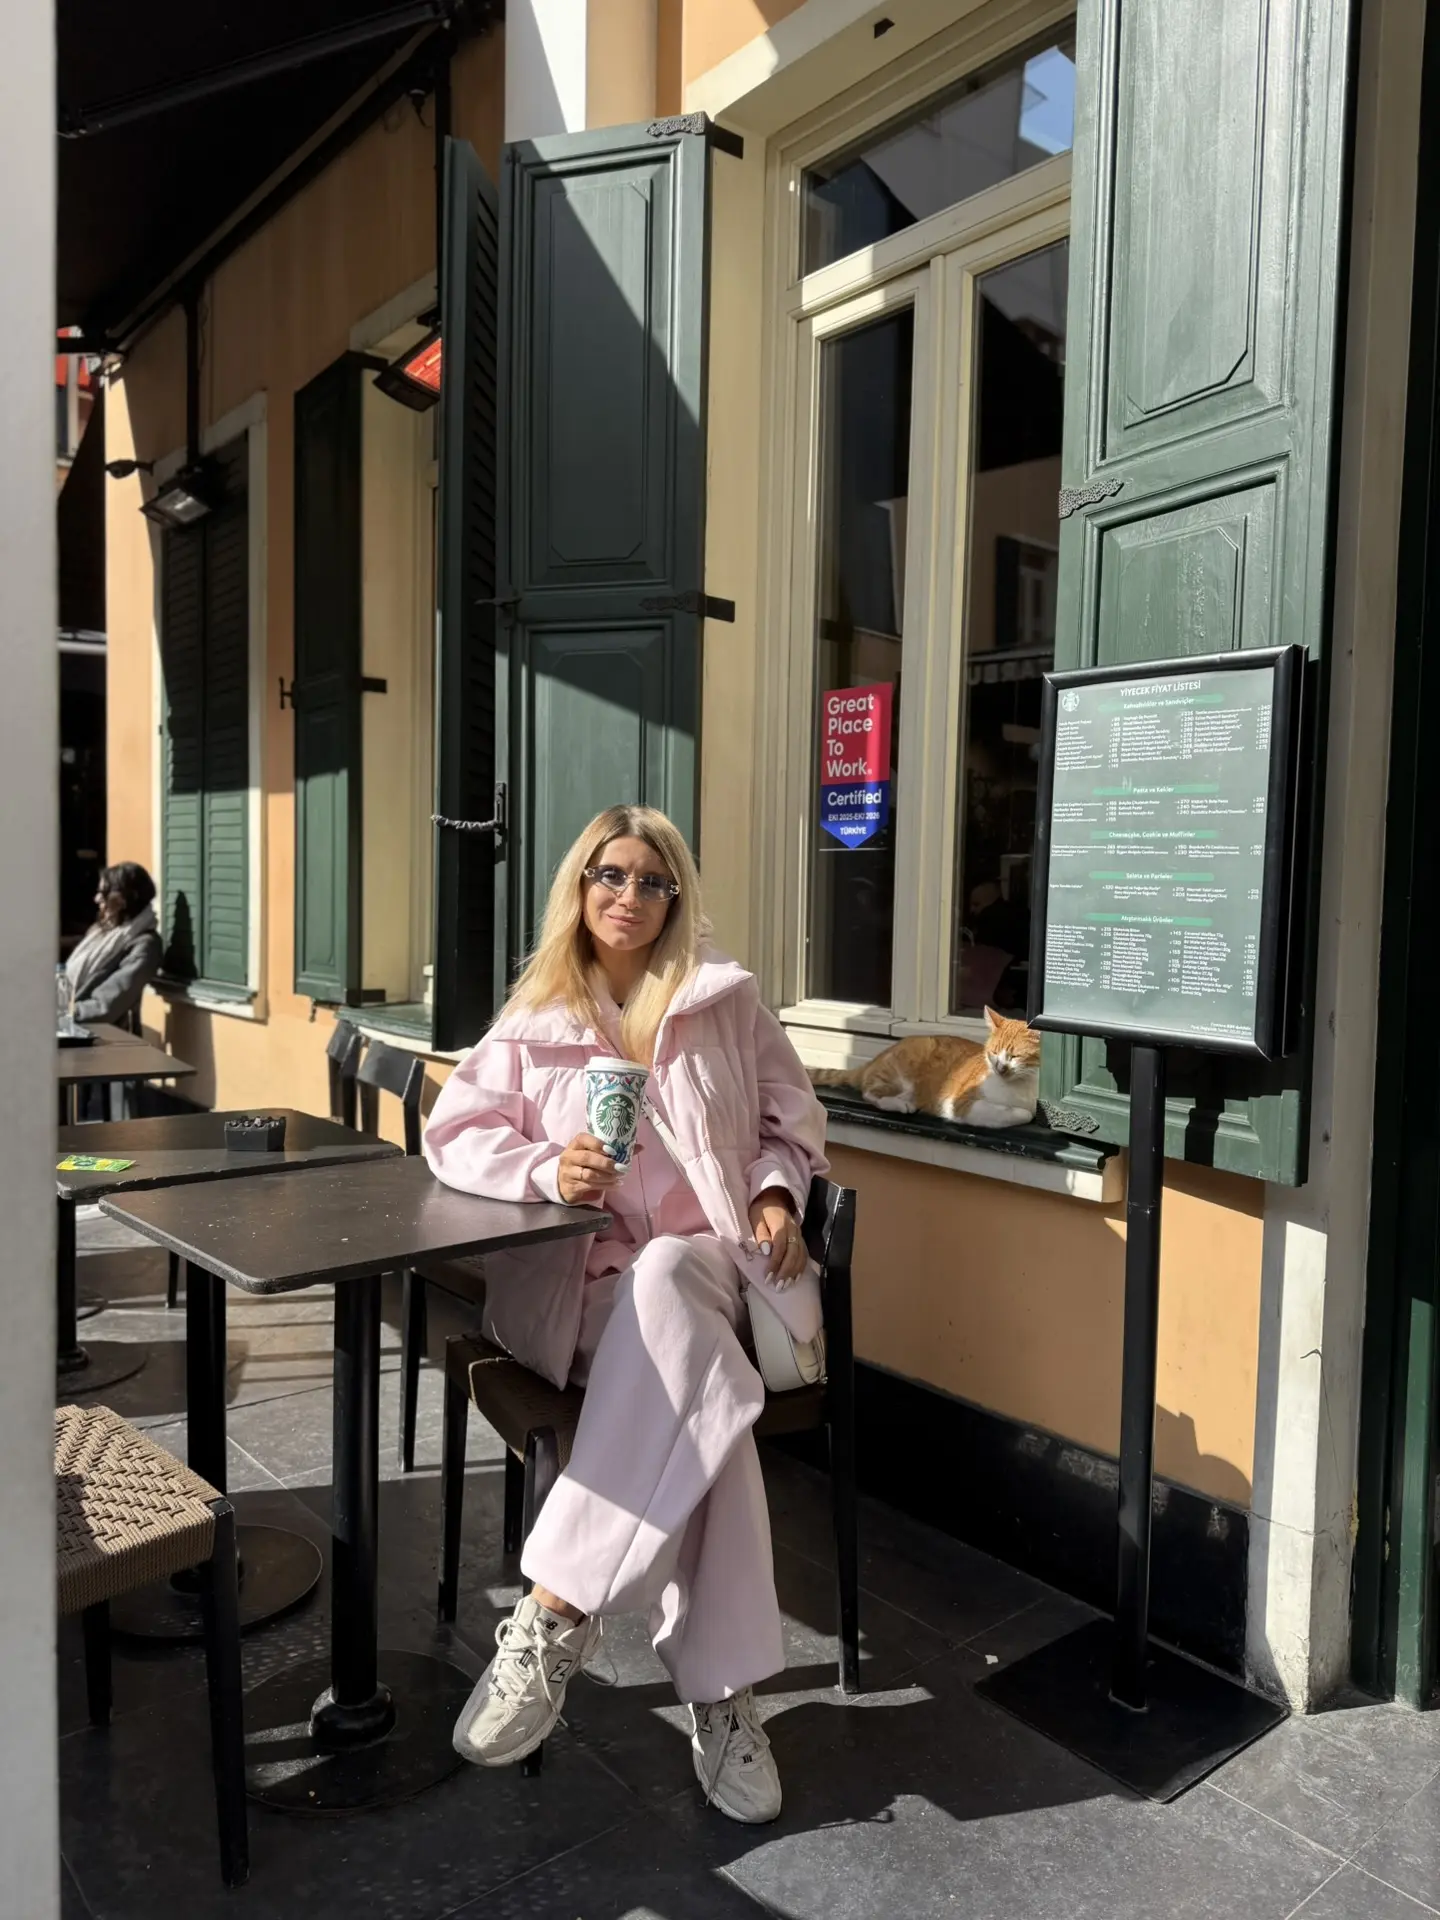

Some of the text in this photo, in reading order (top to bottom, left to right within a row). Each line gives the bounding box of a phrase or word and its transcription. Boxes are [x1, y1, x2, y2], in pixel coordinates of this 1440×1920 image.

[1120, 680, 1201, 697] YİYECEK FİYAT LİSTESİ
[827, 693, 874, 715] Great
[828, 717, 873, 736] Place
[827, 739, 844, 756] To
[827, 788, 882, 806] Certified
[1133, 787, 1148, 795] Pasta
[840, 826, 866, 836] TÜRKİYE
